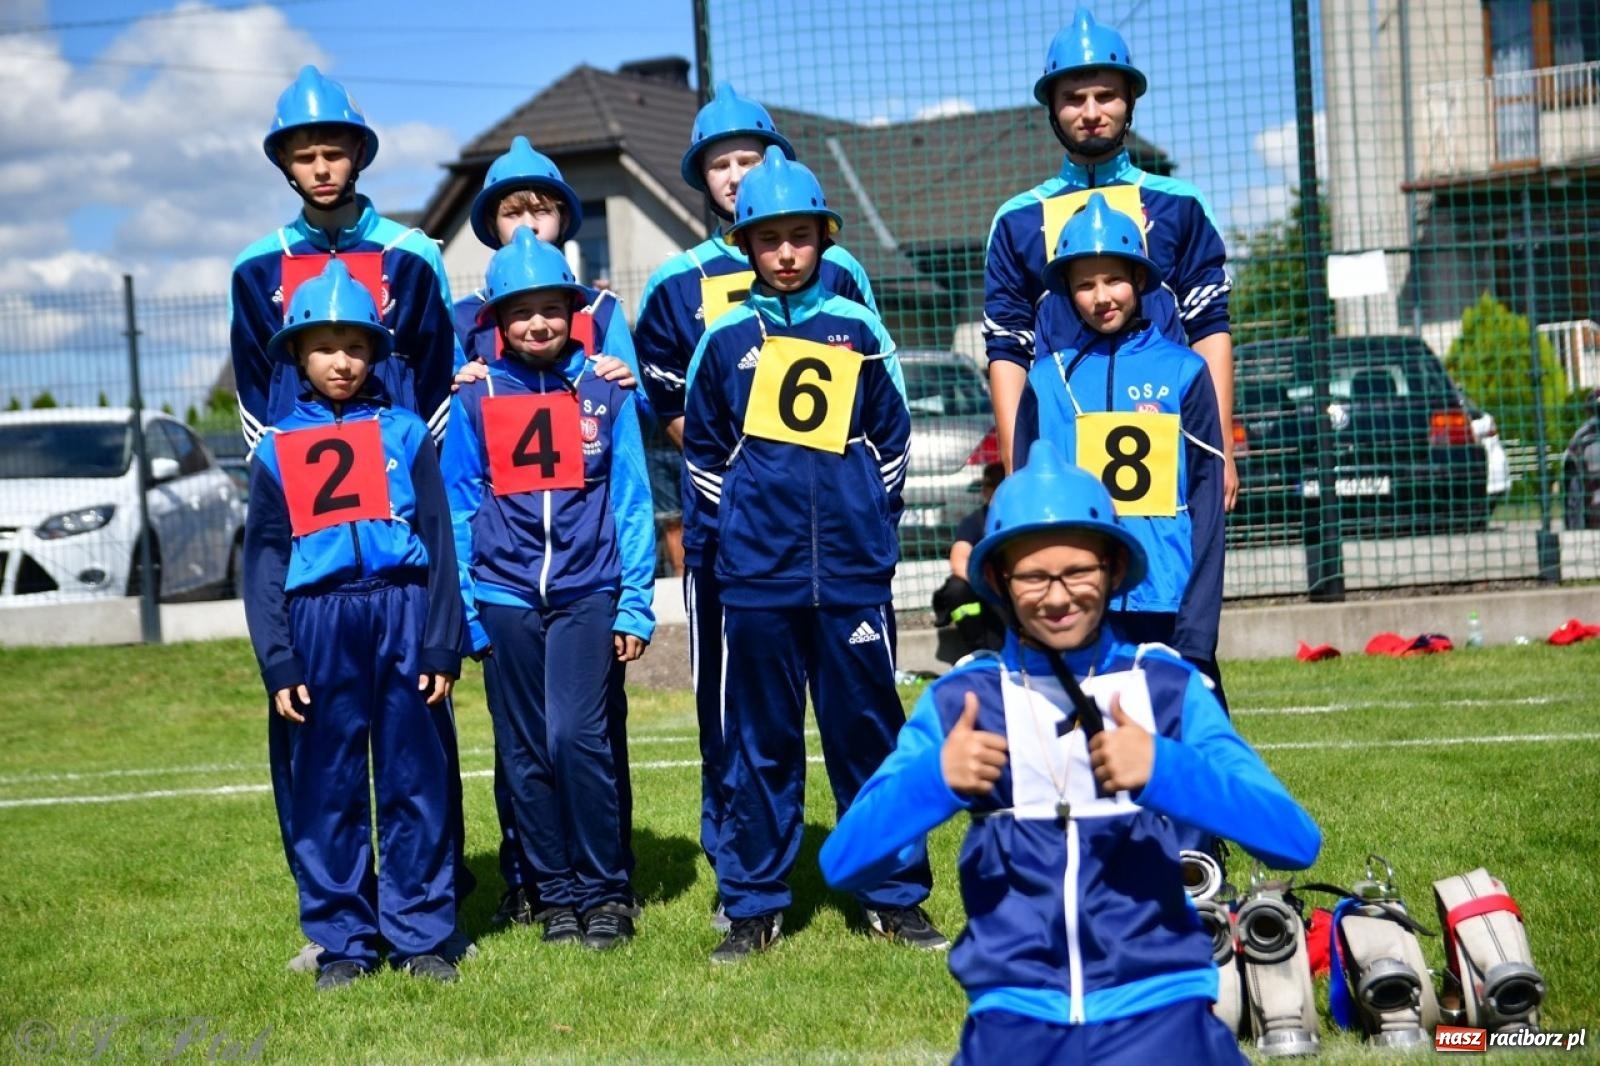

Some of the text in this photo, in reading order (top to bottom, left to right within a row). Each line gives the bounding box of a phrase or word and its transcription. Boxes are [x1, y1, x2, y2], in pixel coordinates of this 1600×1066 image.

[779, 357, 832, 432] 6
[1127, 382, 1170, 401] OSP
[305, 438, 361, 516] 2
[512, 408, 561, 478] 4
[1102, 425, 1151, 502] 8
[848, 632, 881, 645] adidas
